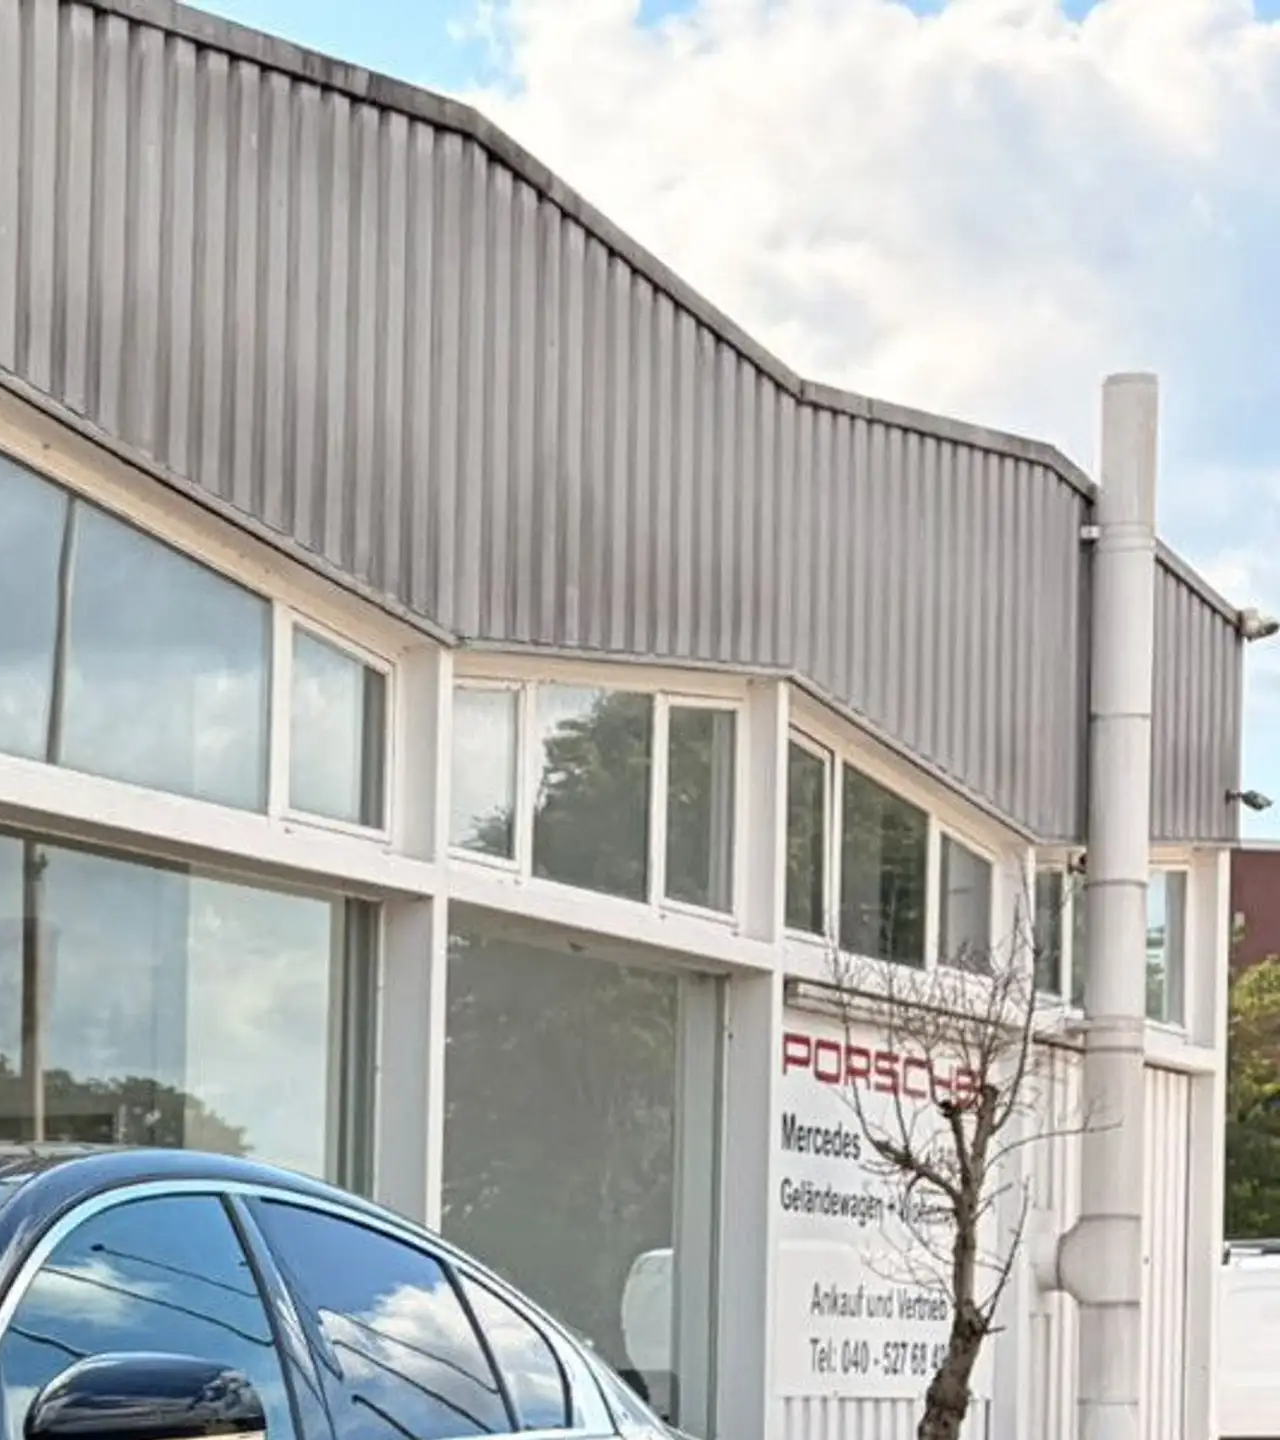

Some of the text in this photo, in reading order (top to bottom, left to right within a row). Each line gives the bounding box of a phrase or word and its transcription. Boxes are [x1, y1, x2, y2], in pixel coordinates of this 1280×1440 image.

[781, 1112, 862, 1161] Mercedes
[780, 1176, 882, 1228] Geländewagen
[809, 1280, 948, 1322] Ankauf und Vertrieb
[841, 1338, 871, 1376] 040
[883, 1341, 909, 1376] 527
